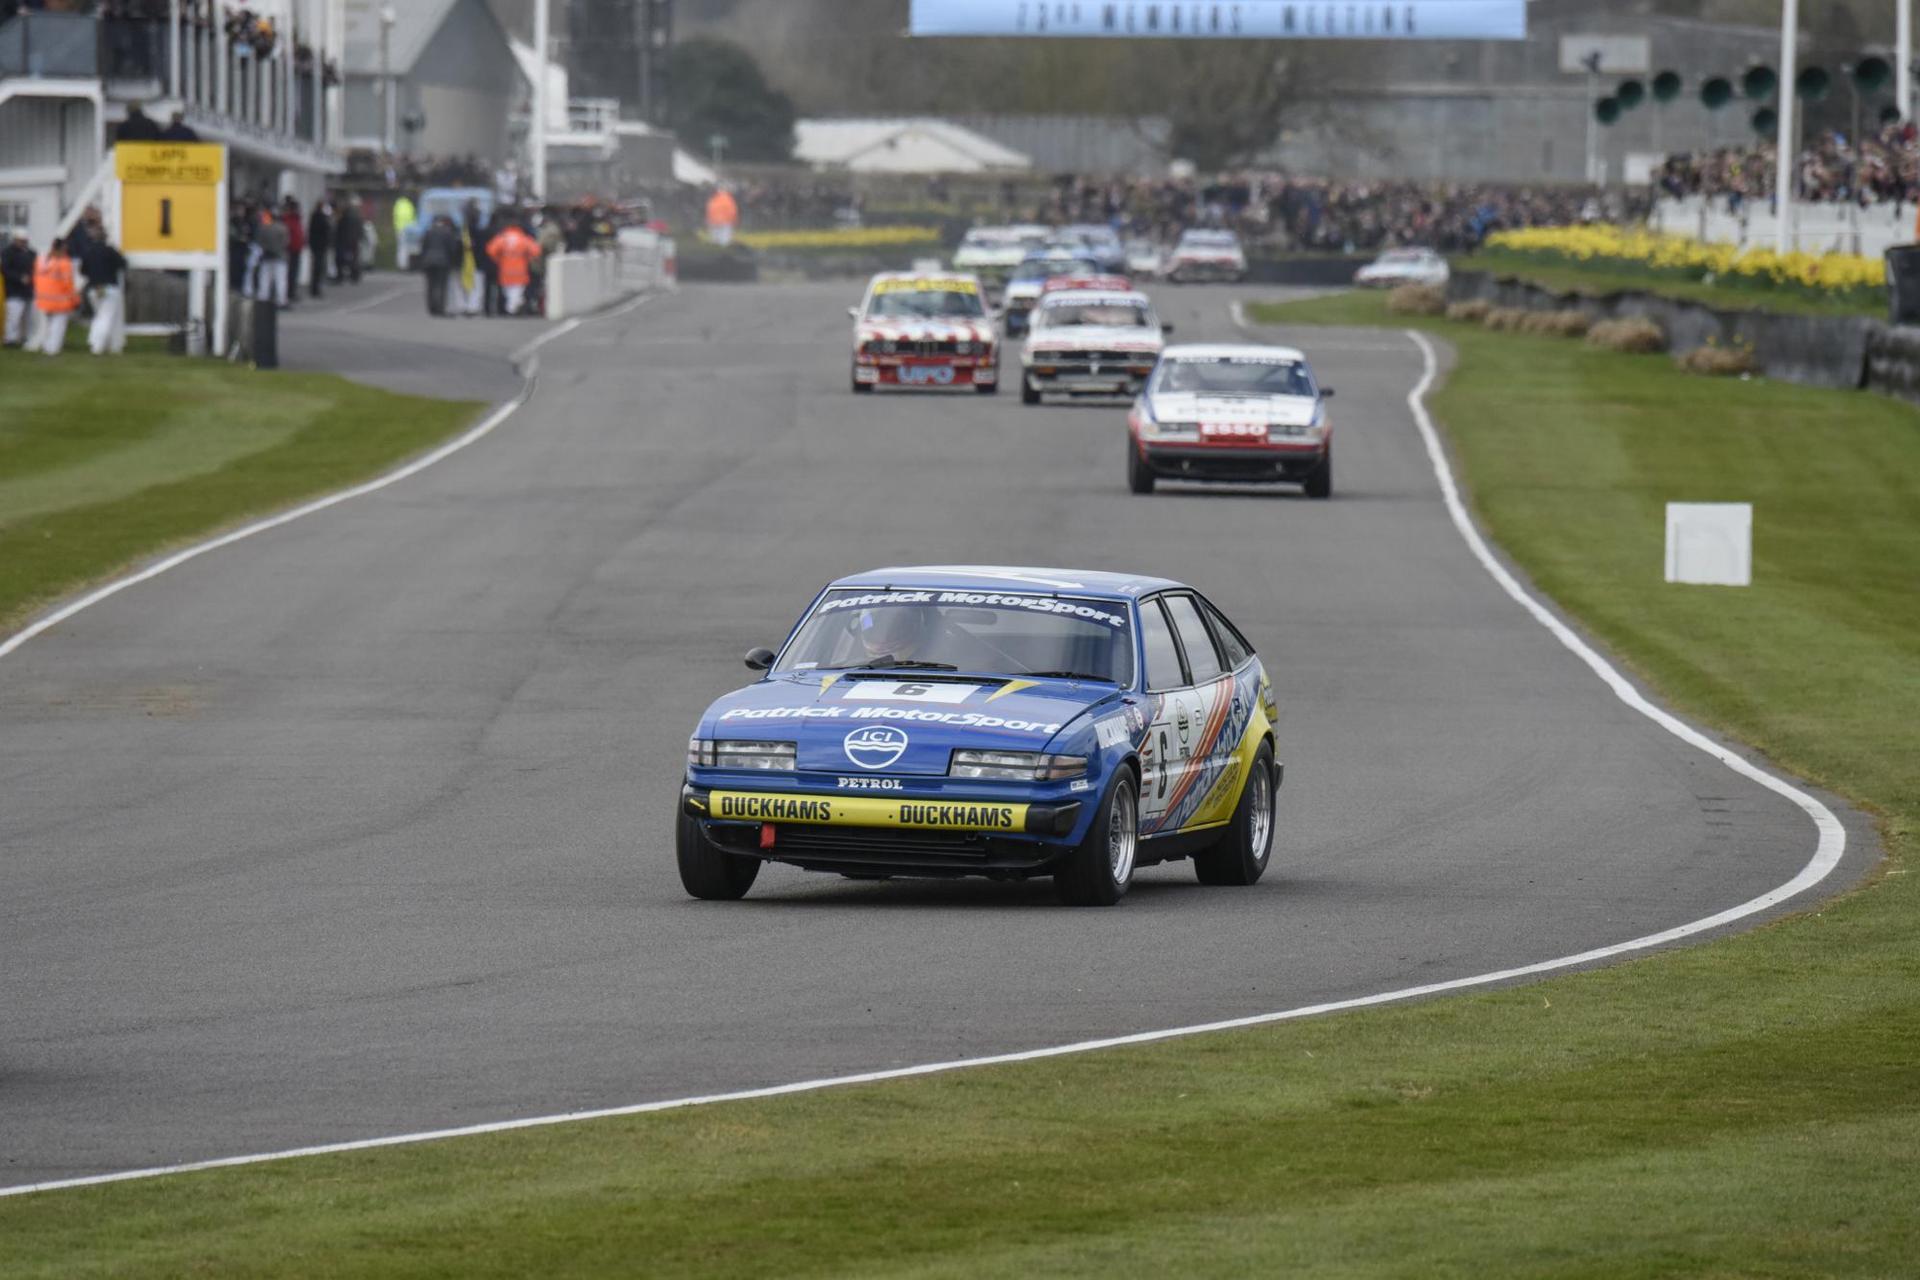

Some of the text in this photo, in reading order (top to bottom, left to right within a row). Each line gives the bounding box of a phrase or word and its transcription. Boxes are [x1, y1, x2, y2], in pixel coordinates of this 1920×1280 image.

[126, 164, 212, 180] COMPLETED
[1201, 423, 1268, 436] ESSO
[818, 591, 1126, 628] Patrick MotorSport
[892, 683, 934, 696] 6
[719, 706, 1061, 734] Patrick MotorSport
[860, 730, 893, 742] ICI
[836, 777, 904, 790] PETROL
[721, 796, 1013, 828] DUCKHAMS DUCKHAMS
